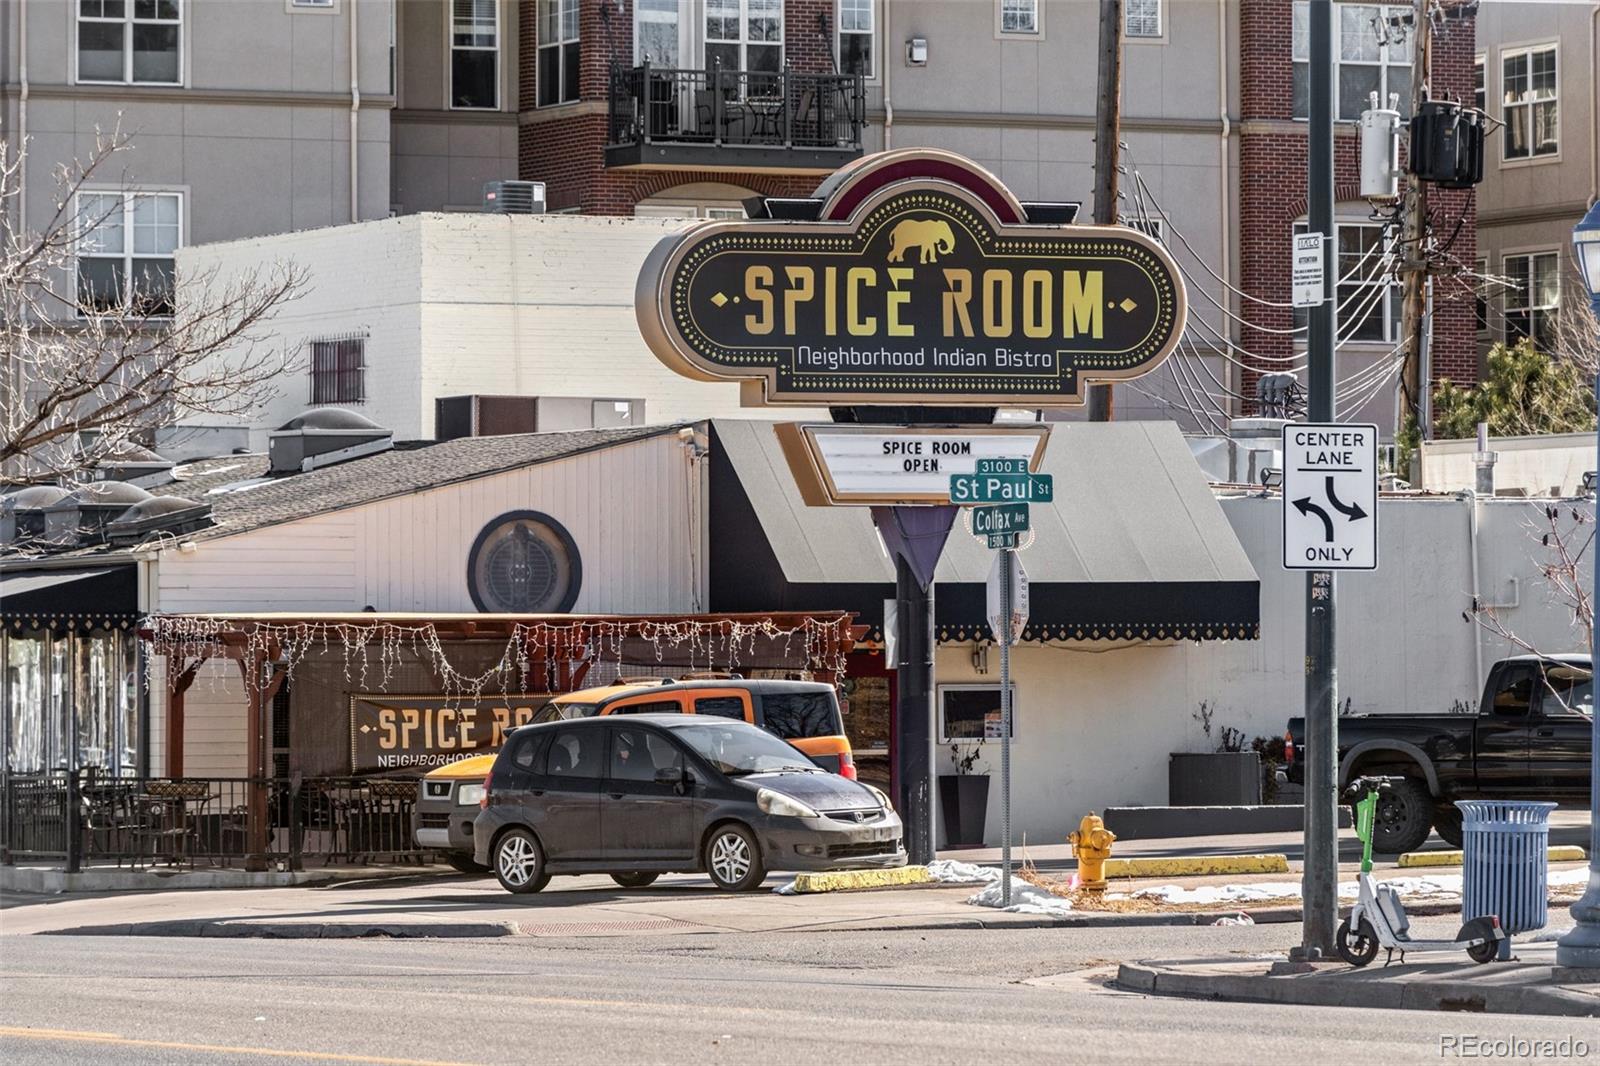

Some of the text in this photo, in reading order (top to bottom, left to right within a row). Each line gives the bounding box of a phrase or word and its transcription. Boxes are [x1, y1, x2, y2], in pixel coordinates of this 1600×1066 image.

[744, 265, 1104, 339] SPICE ROOM
[798, 345, 1052, 370] Neighborhood Indian Bistro
[1295, 432, 1364, 447] CENTER
[882, 441, 971, 455] SPICE ROOM
[1306, 451, 1353, 465] LANE
[903, 459, 939, 472] OPEN
[982, 461, 1025, 472] 3100 E
[955, 478, 1049, 499] St Paul St
[976, 510, 1025, 530] Colfax Ave
[989, 535, 1013, 547] 1500 N
[1305, 547, 1354, 561] ONLY
[378, 708, 477, 749] SPICE
